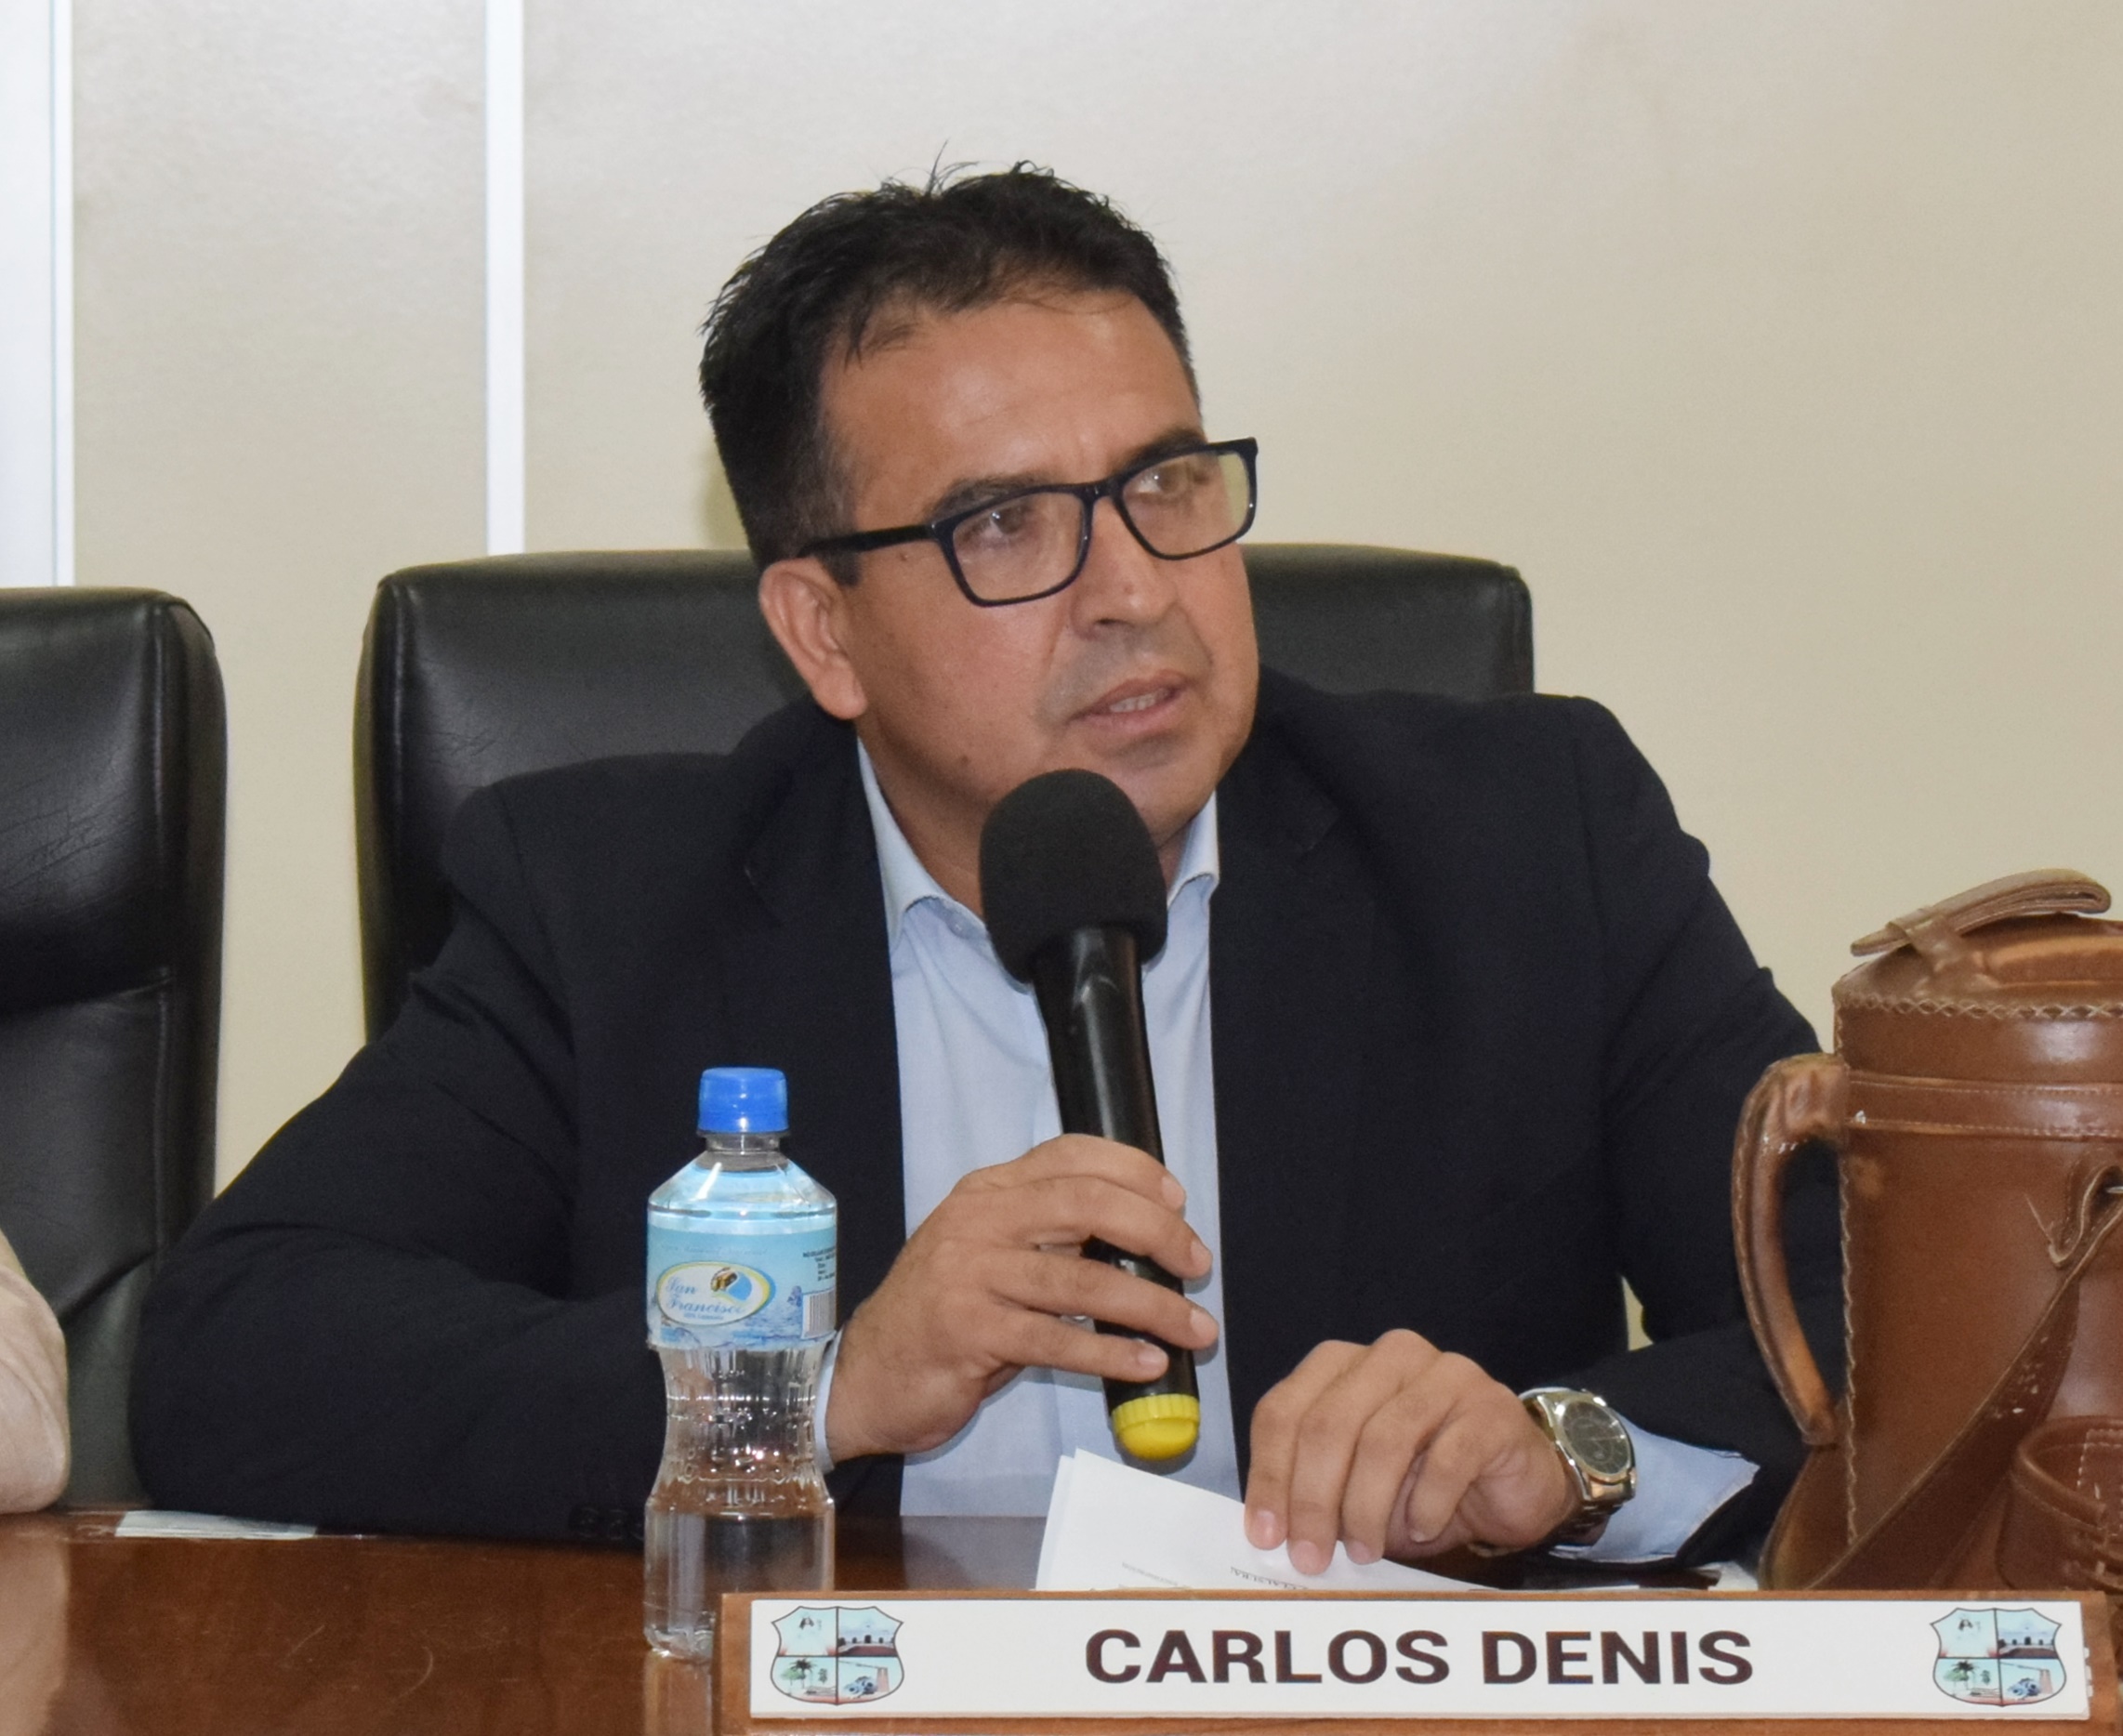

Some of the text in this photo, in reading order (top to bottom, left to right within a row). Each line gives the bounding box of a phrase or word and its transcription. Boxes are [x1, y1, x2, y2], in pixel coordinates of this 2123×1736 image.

[666, 1275, 696, 1295] San
[666, 1293, 745, 1313] Francisco
[1085, 1628, 1754, 1686] CARLOS DENIS
